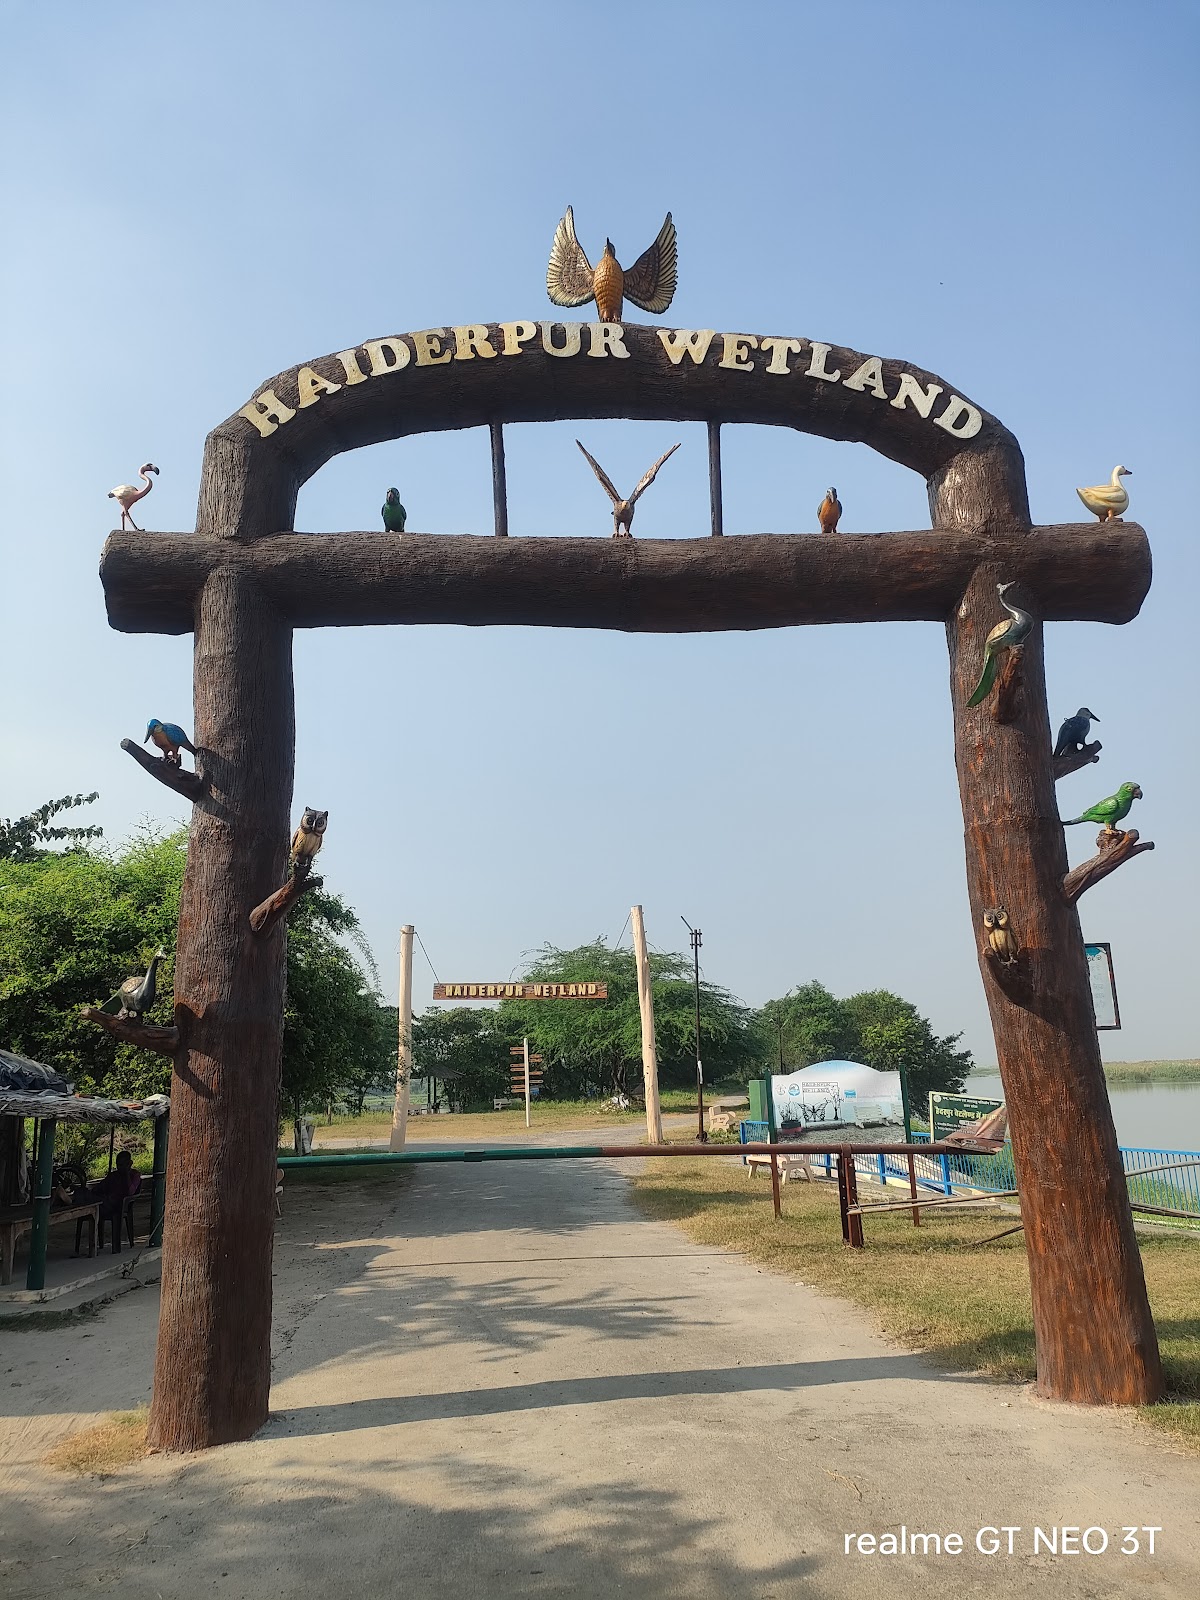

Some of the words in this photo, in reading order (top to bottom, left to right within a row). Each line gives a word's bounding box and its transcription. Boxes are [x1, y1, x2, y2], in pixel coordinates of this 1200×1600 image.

[239, 320, 631, 437] HAIDERPUR
[657, 329, 983, 439] WETLAND
[445, 984, 523, 997] HAIDERPUR
[533, 983, 597, 997] WETLAND
